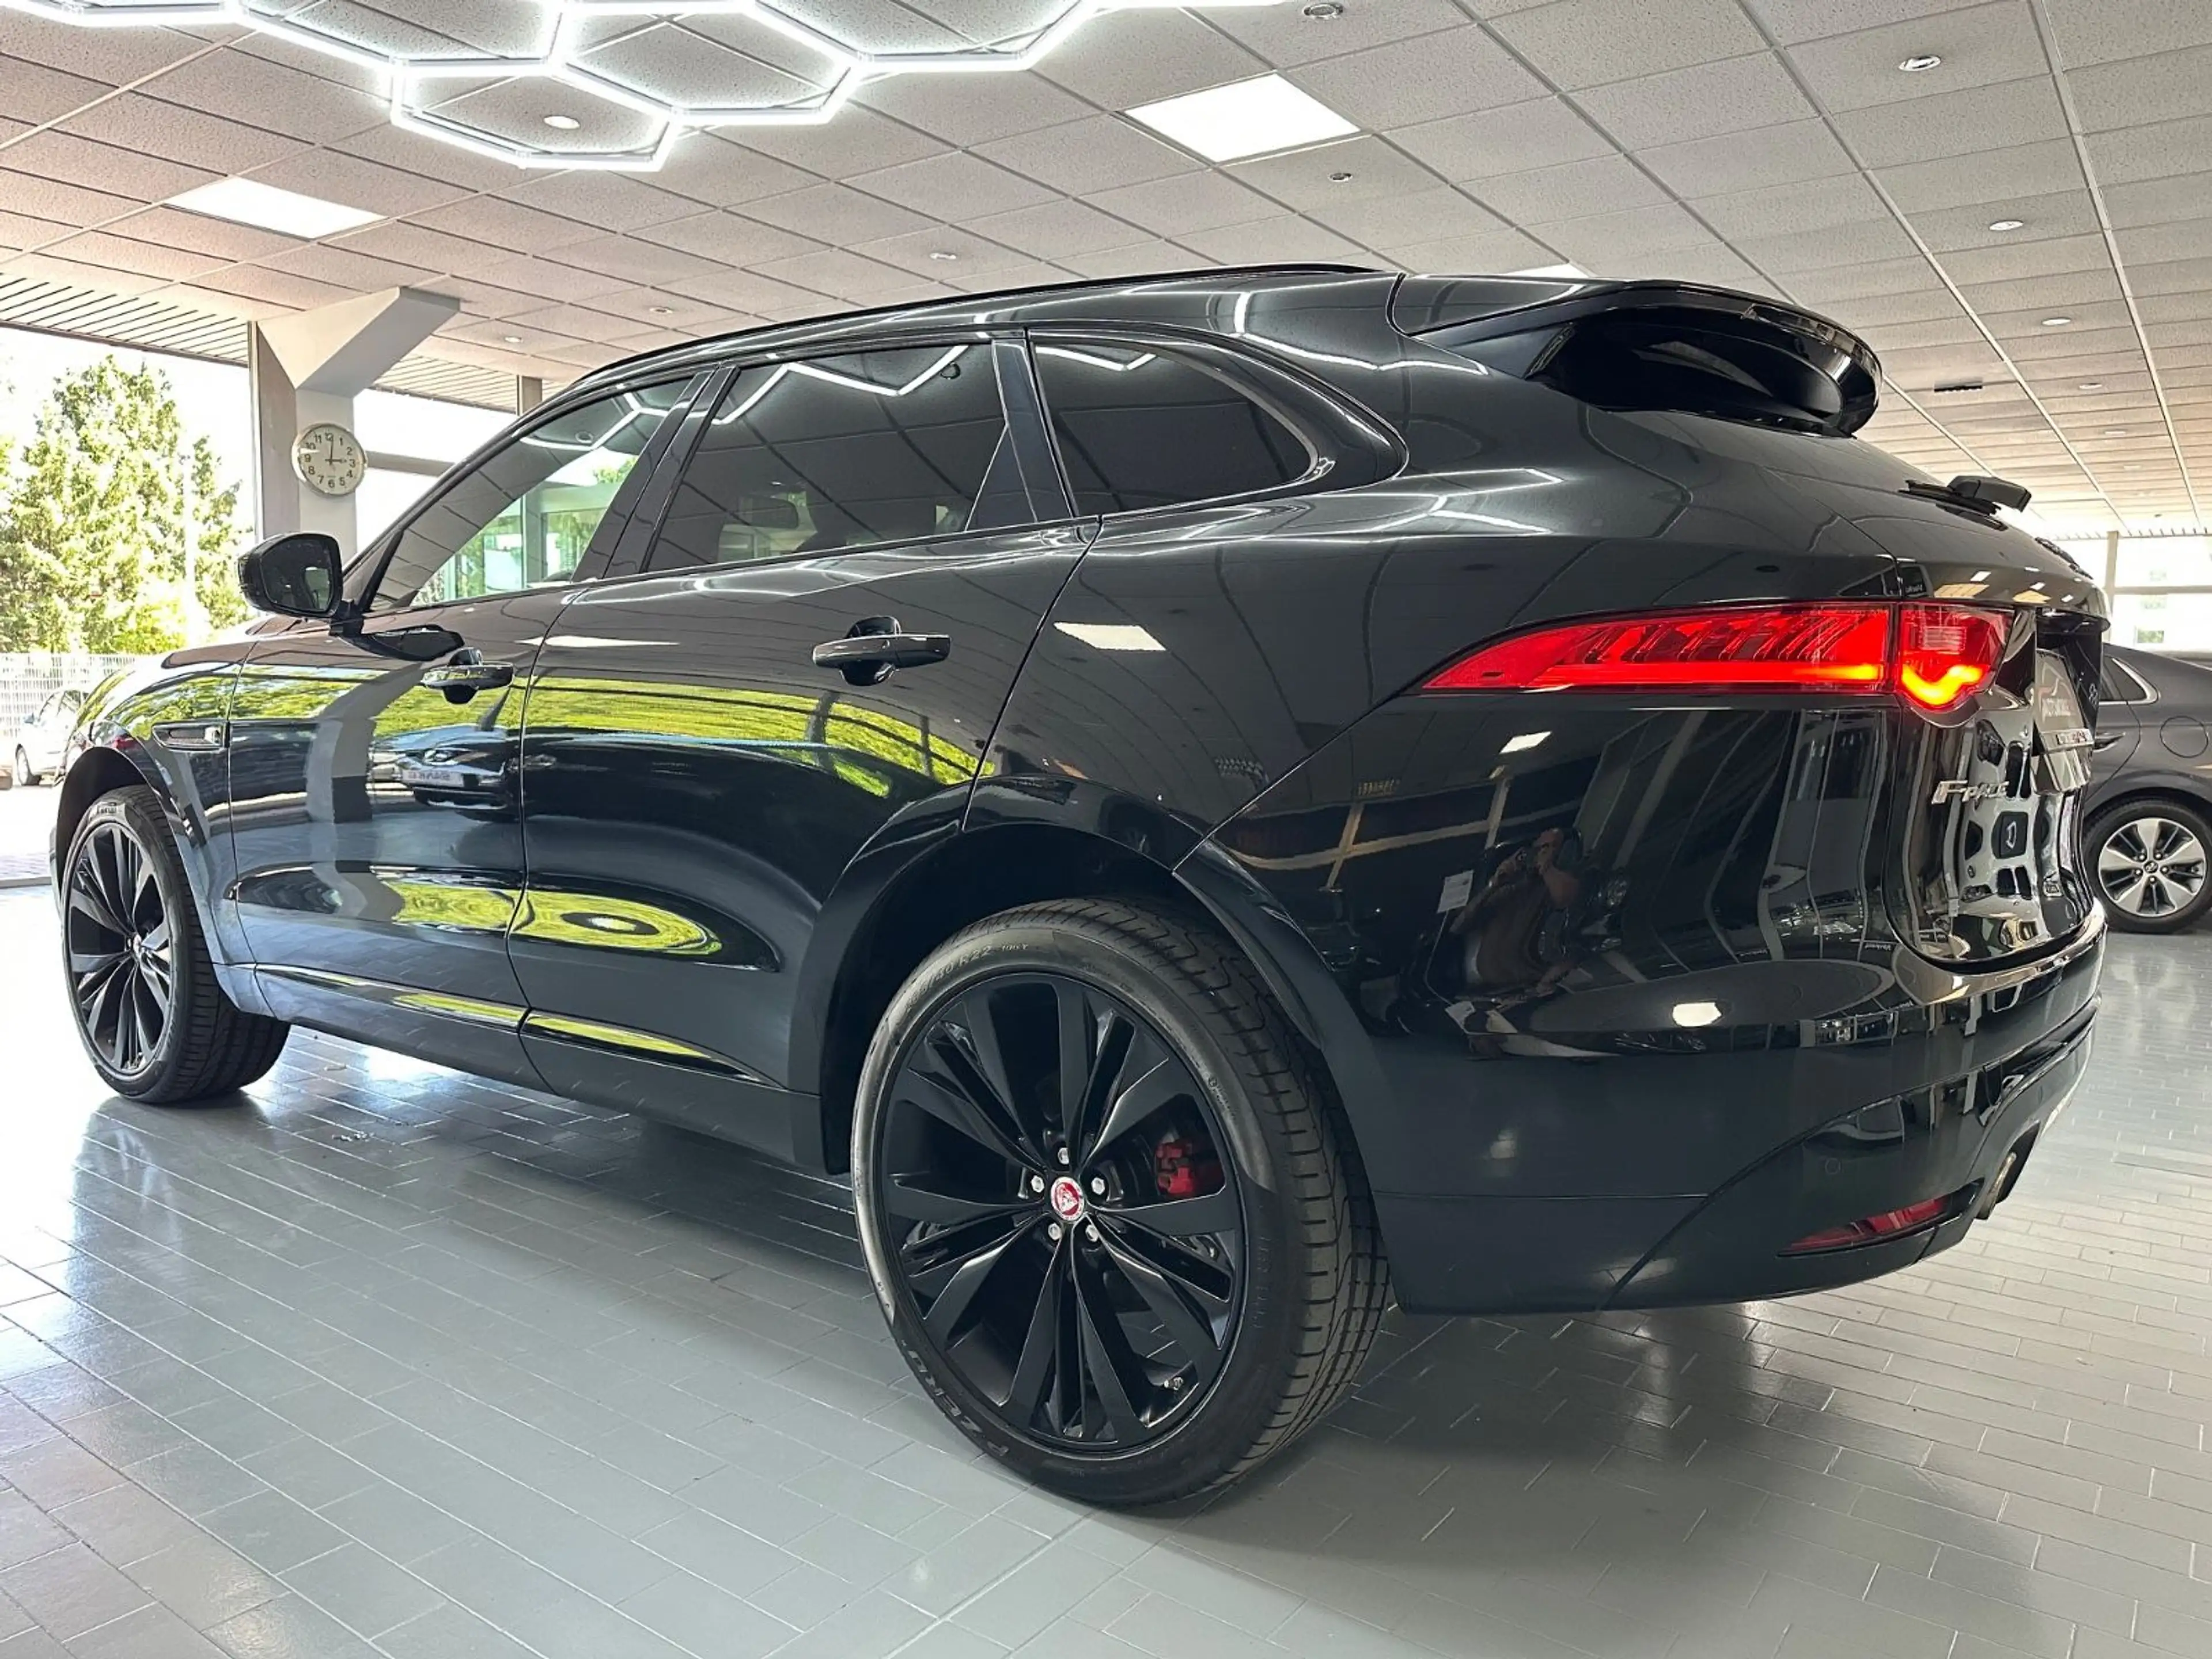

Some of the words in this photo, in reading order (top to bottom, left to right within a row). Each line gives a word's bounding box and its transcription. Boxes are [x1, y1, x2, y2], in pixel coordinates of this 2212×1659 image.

[314, 434, 321, 444] 11
[339, 437, 343, 445] 1
[347, 447, 353, 455] 2
[304, 454, 311, 462] 9
[350, 459, 355, 468] 3
[308, 466, 316, 475] 8
[328, 479, 335, 488] 6
[339, 477, 346, 486] 5
